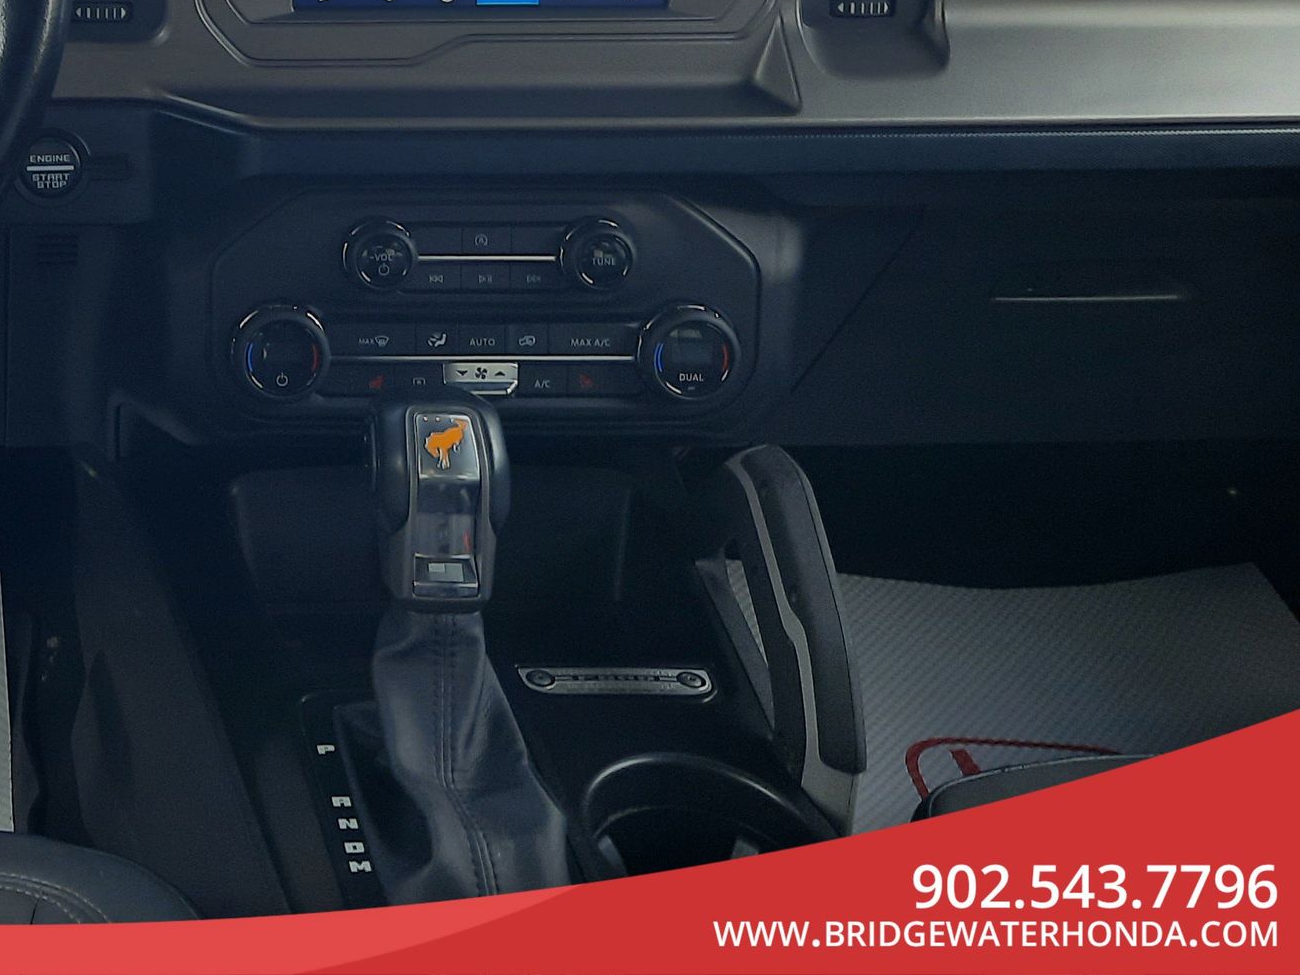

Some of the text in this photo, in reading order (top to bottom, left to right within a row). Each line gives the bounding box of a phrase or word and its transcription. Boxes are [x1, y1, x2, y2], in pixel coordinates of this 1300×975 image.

[29, 154, 70, 163] ENGINE
[32, 173, 70, 182] START
[37, 181, 67, 189] STOP
[591, 257, 616, 266] TUNE
[358, 337, 375, 345] MAX
[469, 337, 496, 347] AUTO
[570, 337, 611, 347] MAX A/C
[679, 373, 704, 382] DUAL
[534, 379, 550, 389] A/C
[316, 744, 335, 755] P
[337, 818, 359, 829] N
[343, 841, 365, 853] D
[348, 860, 372, 872] M
